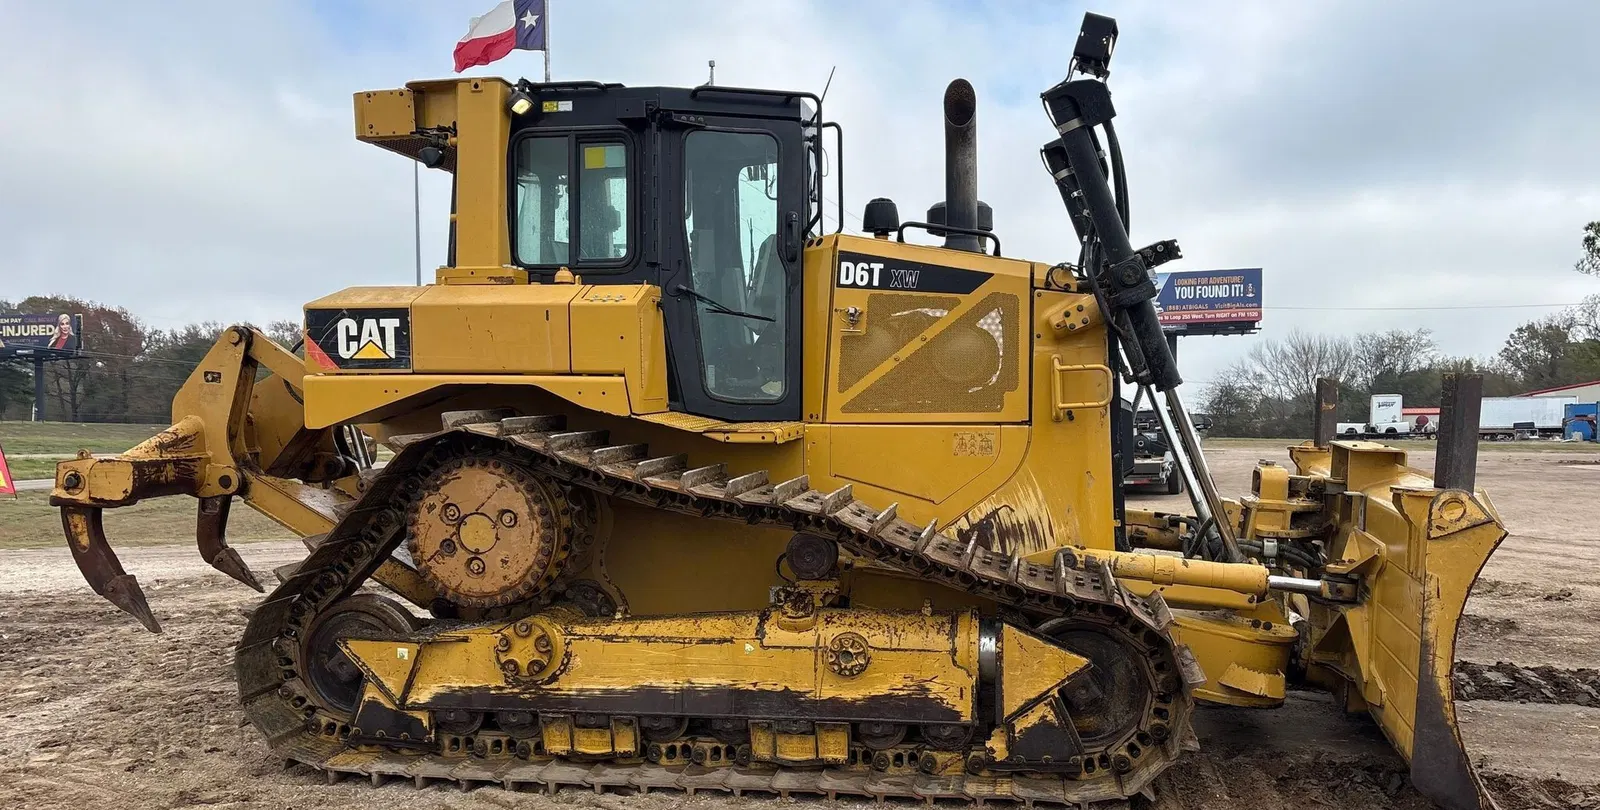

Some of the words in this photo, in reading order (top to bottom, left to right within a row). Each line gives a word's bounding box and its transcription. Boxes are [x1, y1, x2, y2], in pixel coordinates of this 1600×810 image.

[839, 261, 884, 287] D6T
[890, 269, 920, 289] XW
[1174, 278, 1197, 286] LOOKING
[1198, 277, 1208, 285] FOR
[1209, 276, 1244, 284] ADVENTURE?
[1174, 286, 1194, 299] YOU
[1196, 285, 1229, 298] FOUND
[1231, 284, 1243, 297] IT!
[337, 318, 400, 359] CAT
